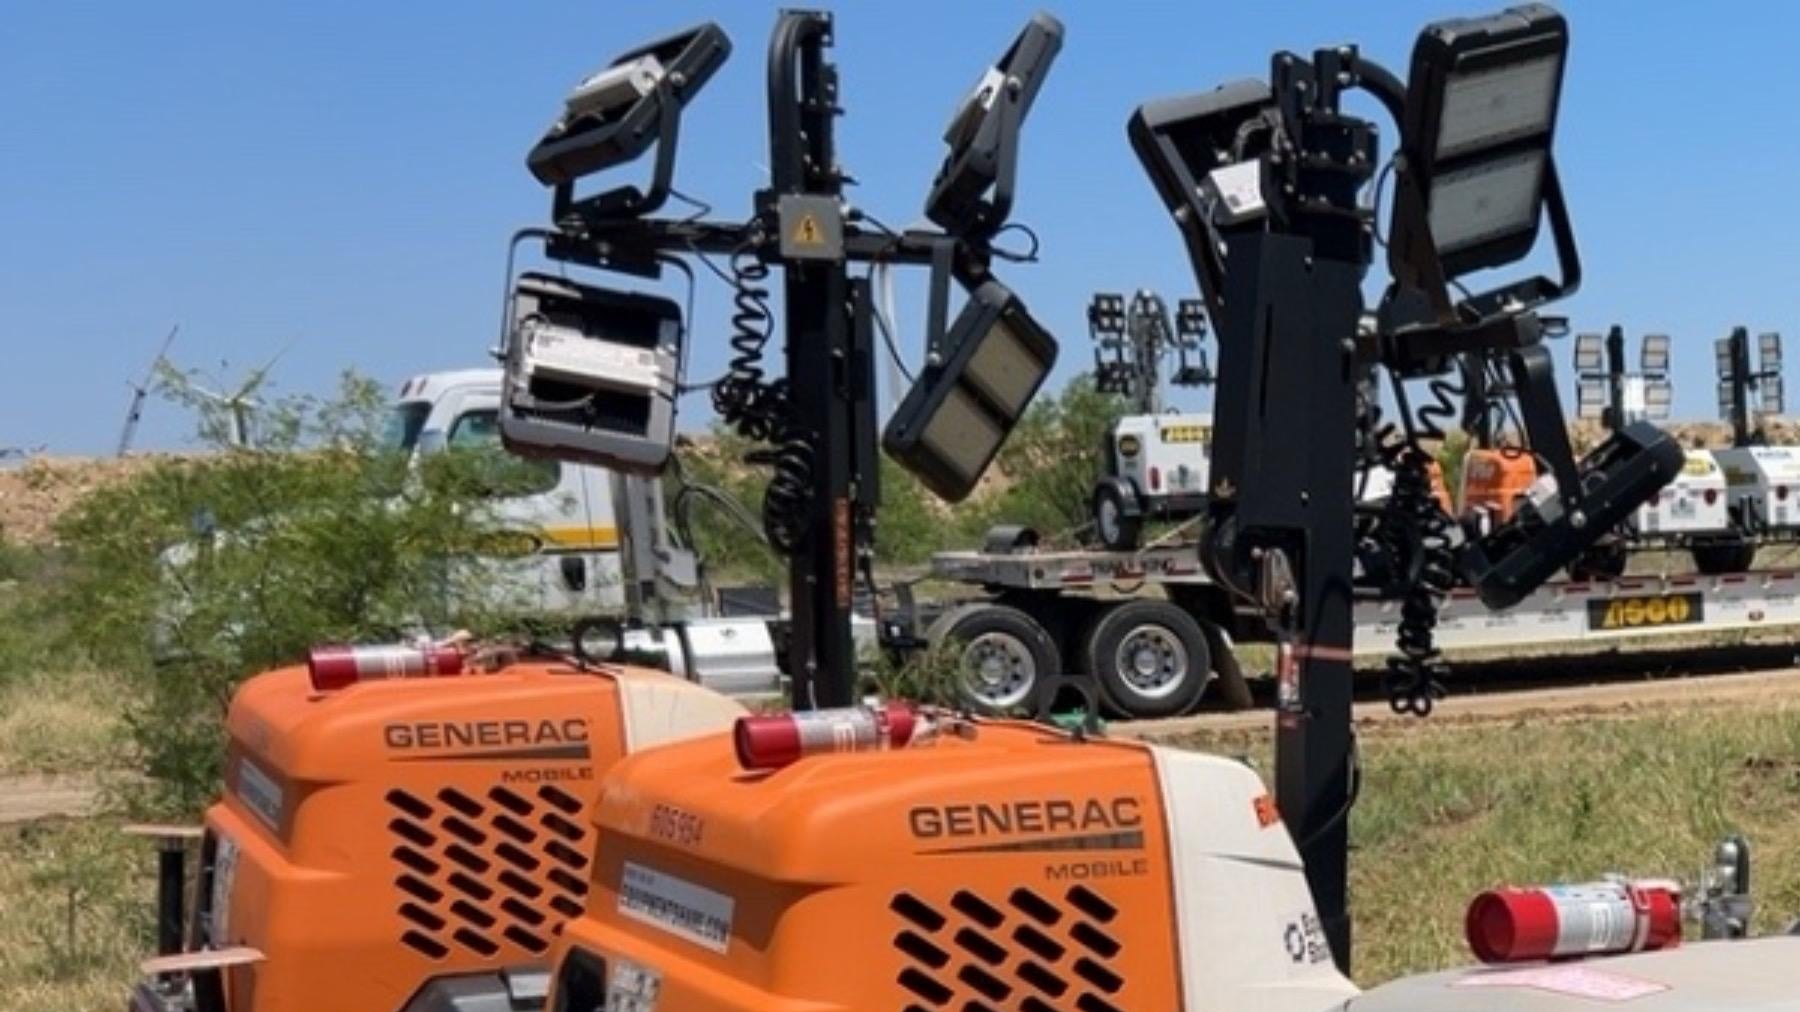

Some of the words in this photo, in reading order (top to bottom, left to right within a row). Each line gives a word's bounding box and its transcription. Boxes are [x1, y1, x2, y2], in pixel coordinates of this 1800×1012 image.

[384, 718, 589, 749] GENERAC
[501, 767, 594, 783] MOBILE
[908, 797, 1142, 838] GENERAC
[1044, 858, 1149, 880] MOBILE
